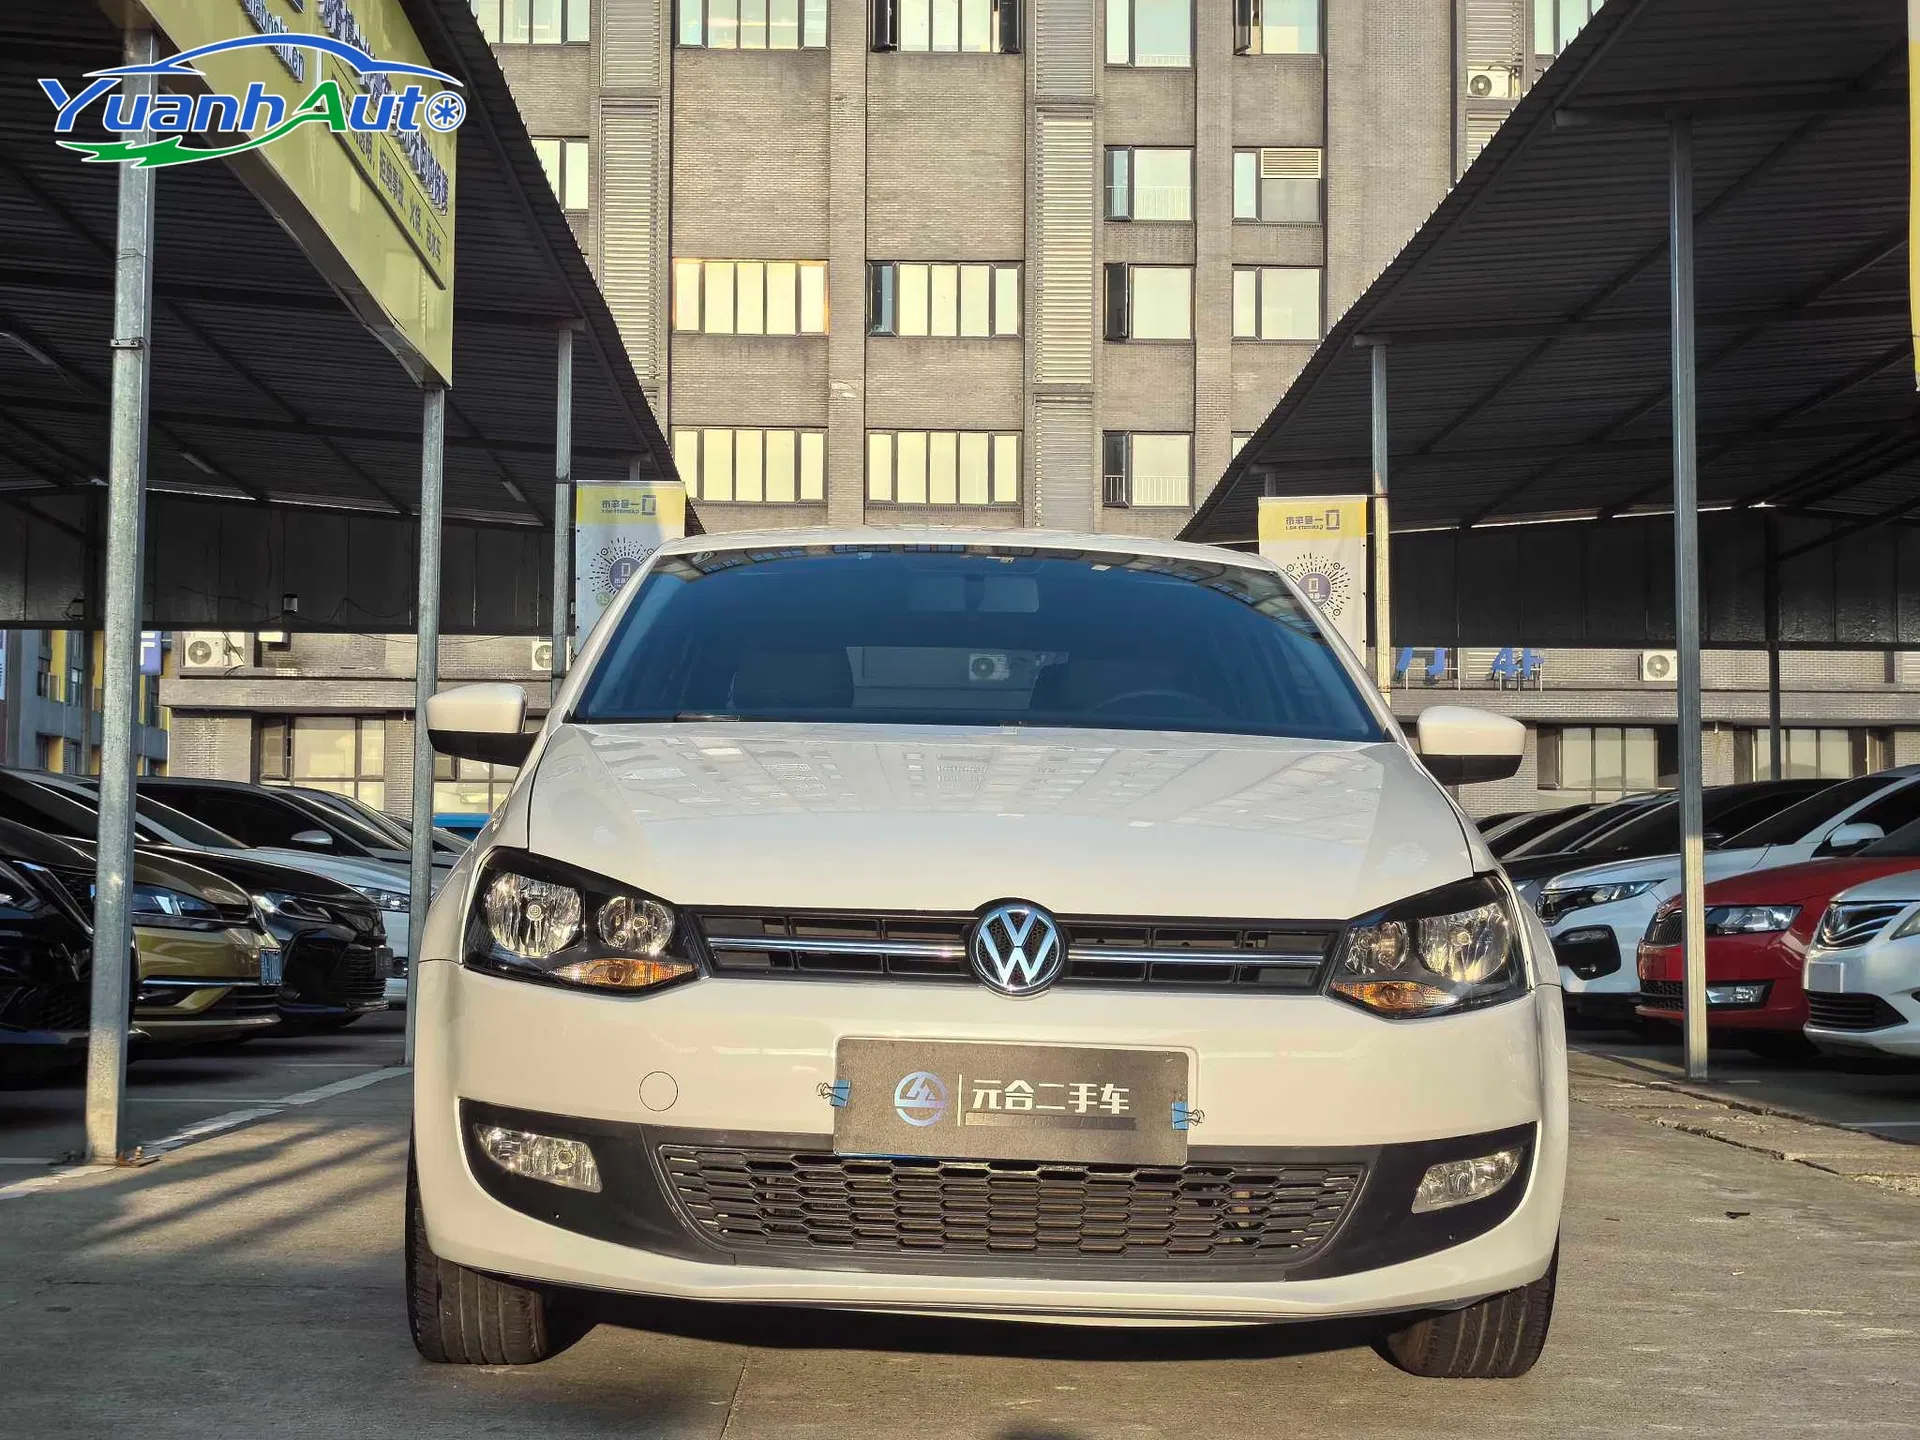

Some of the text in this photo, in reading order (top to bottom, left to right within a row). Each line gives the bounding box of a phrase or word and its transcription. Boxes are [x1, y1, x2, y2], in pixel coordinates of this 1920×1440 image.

[972, 1079, 1130, 1115] 元合二手车
